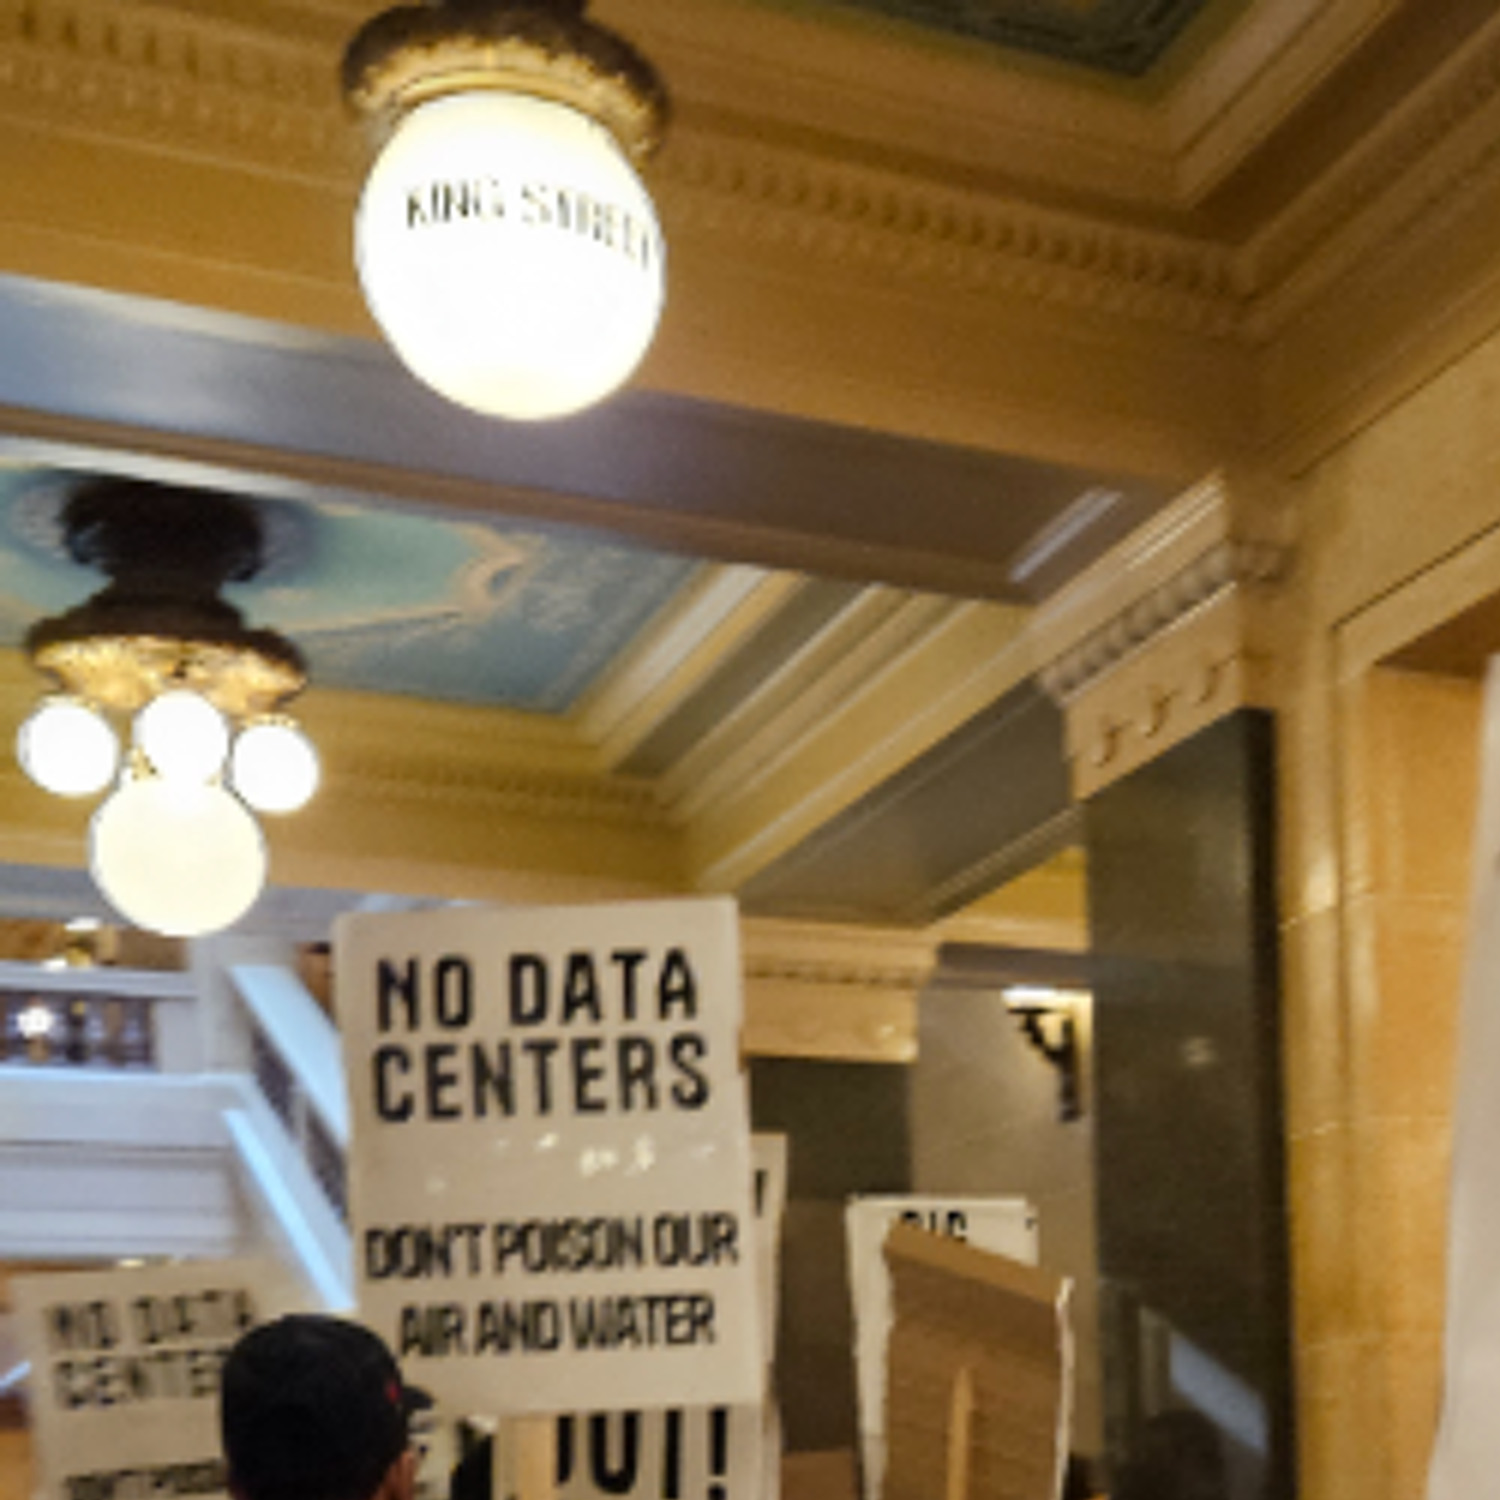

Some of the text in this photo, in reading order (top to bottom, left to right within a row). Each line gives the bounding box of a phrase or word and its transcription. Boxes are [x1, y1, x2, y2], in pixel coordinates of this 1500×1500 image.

[407, 175, 505, 229] KING
[376, 947, 698, 1032] NO DATA
[373, 1032, 710, 1123] CENTERS
[364, 1211, 740, 1280] DON'T POISON OUR
[401, 1293, 716, 1357] AIR AND WATER
